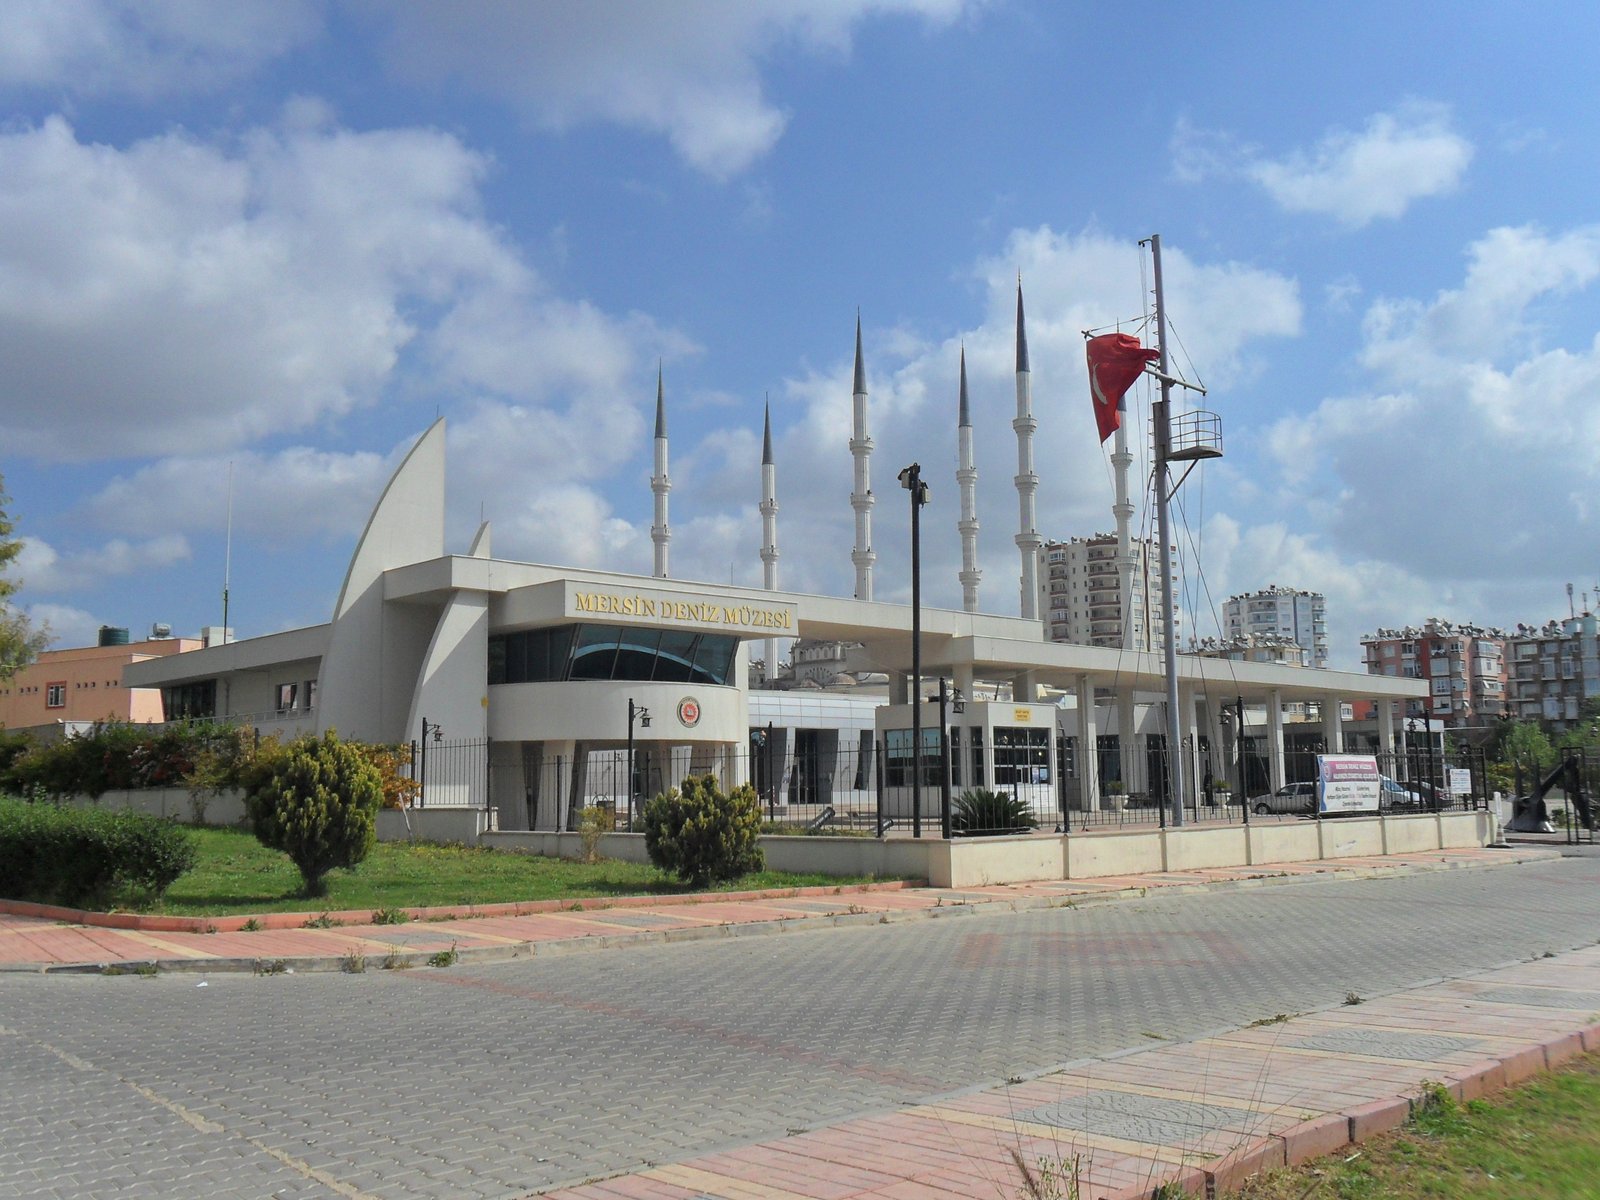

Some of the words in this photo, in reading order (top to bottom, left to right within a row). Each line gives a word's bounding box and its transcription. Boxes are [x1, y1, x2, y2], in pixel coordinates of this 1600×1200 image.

[575, 592, 656, 617] MERSİN
[660, 601, 721, 623] DENİZ
[723, 605, 792, 629] MÜZESİ
